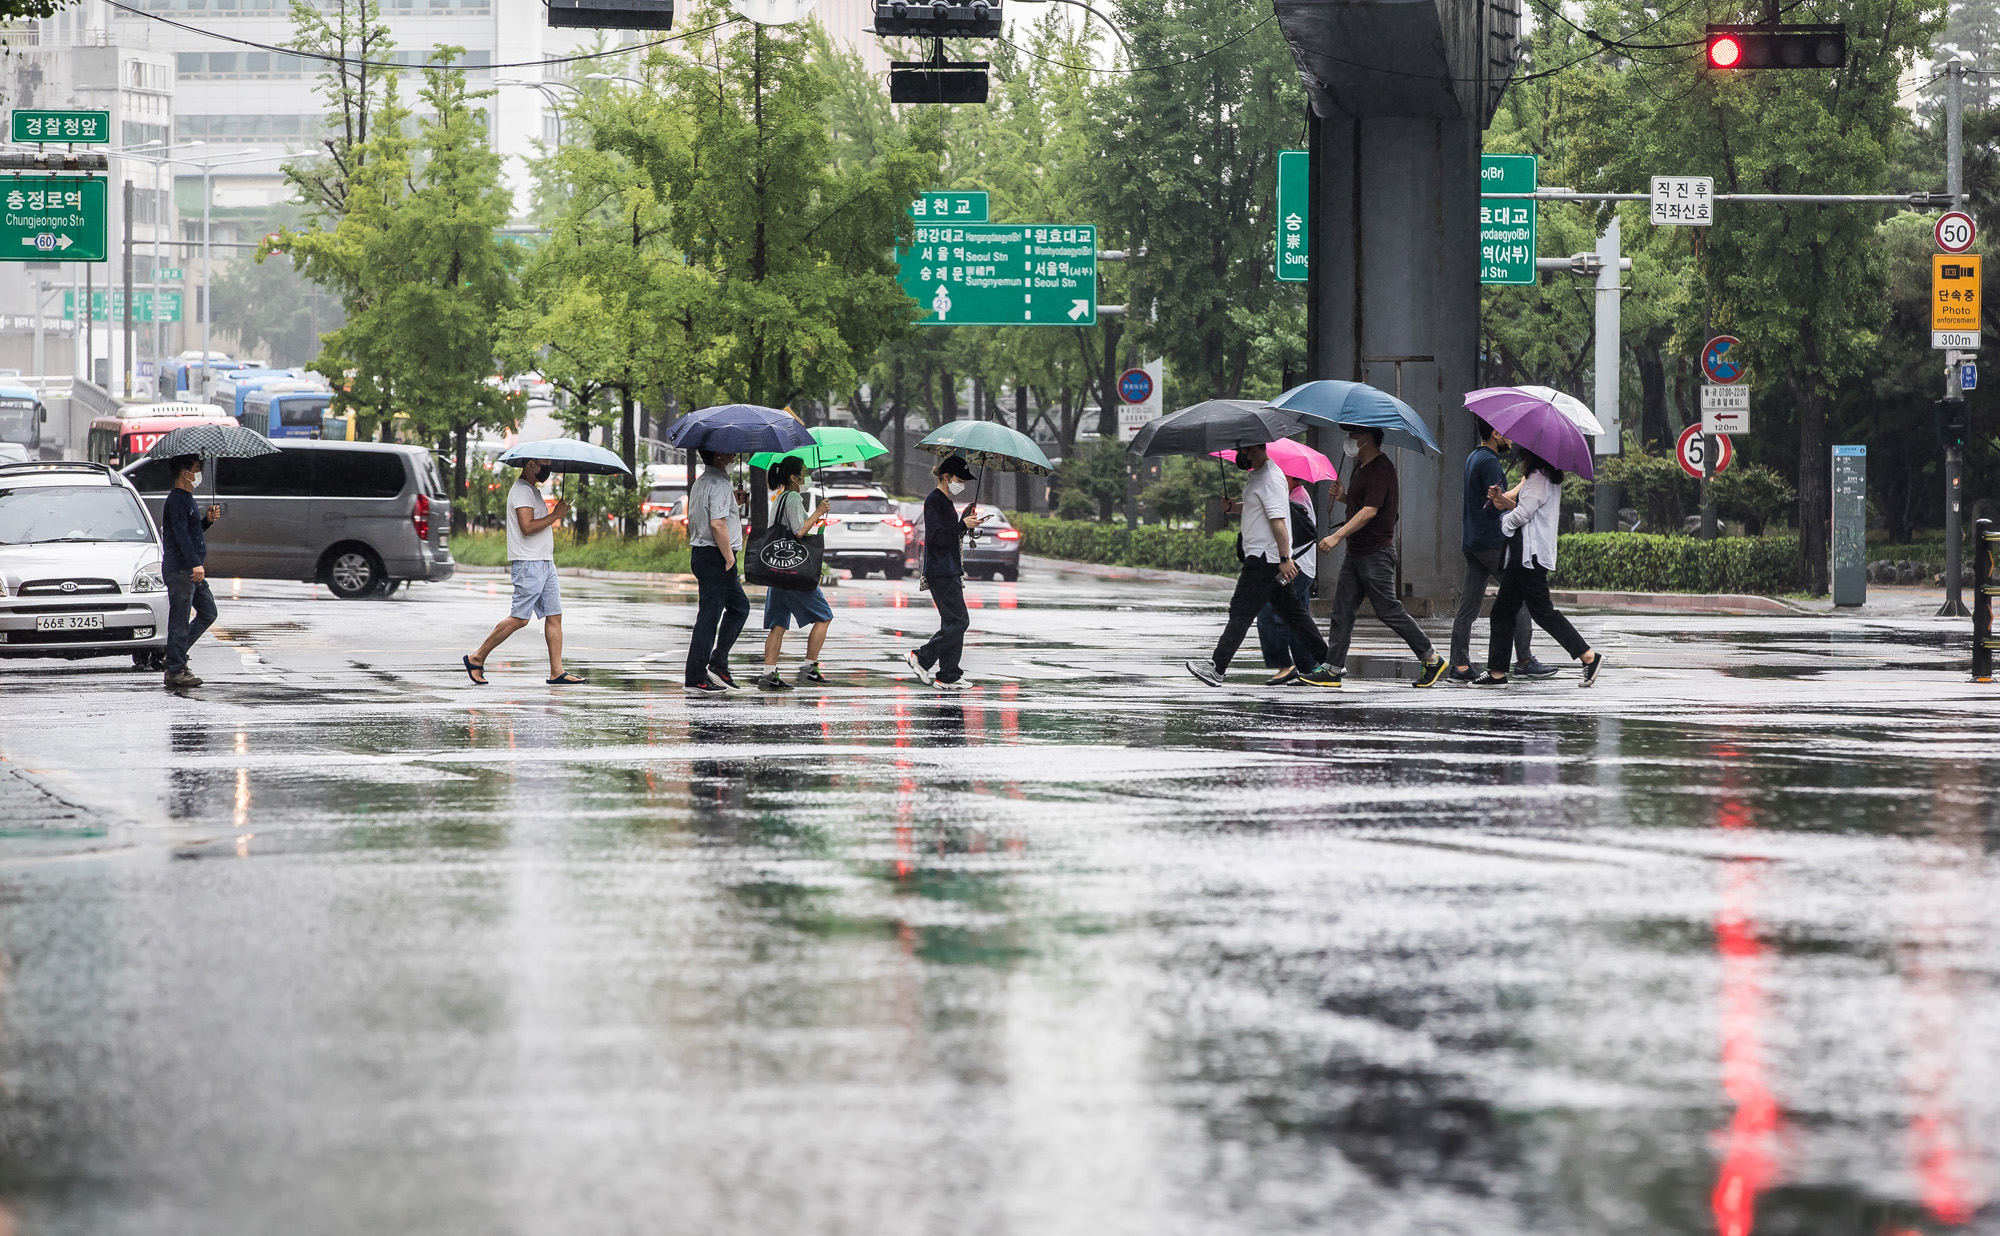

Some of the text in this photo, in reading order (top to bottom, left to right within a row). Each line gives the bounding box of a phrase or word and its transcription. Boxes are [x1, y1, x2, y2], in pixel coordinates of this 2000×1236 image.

[26, 117, 98, 137] 경찰청앞
[6, 190, 83, 211] 충정로역
[1655, 202, 1710, 220] 직좌신호
[5, 213, 85, 229] Chungjeongno Stn
[1284, 212, 1303, 231] 숭
[916, 228, 964, 243] 한강대교
[1034, 228, 1092, 243] 원효대교
[1943, 224, 1968, 243] 50
[39, 236, 52, 248] 60
[965, 251, 1009, 262] Seoul Stn
[1490, 266, 1508, 278] Stn
[965, 276, 1022, 288] Sungnyemun
[1034, 277, 1077, 288] Seoul Stn
[1939, 289, 1975, 302] 단속중
[936, 299, 949, 310] 21
[1942, 305, 1971, 315] Photo
[1936, 316, 1976, 324] enforcement
[1941, 334, 1971, 346] 300m
[43, 617, 99, 629] 66로 3245
